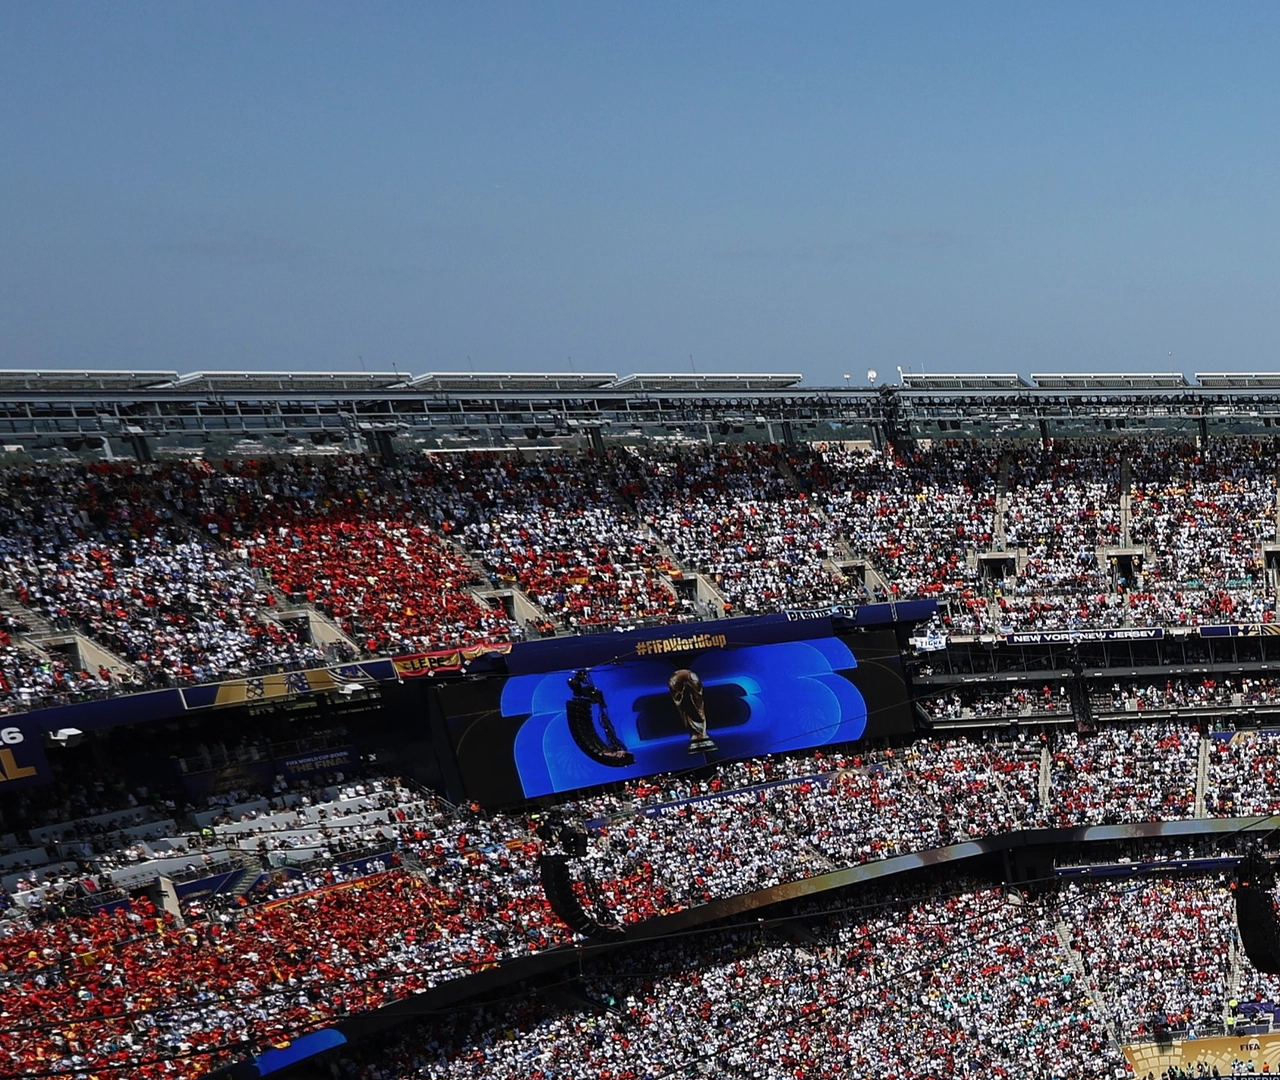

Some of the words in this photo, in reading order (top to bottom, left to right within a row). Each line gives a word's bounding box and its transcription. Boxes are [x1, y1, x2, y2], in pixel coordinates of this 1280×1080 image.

[1013, 633, 1041, 642] NEW
[1079, 631, 1106, 640] NEW
[1109, 630, 1157, 640] JERSEY
[636, 634, 727, 656] #FIFAWorldCup
[411, 656, 445, 671] LEPE
[0, 726, 25, 746] 6
[289, 762, 315, 774] THE
[315, 757, 353, 769] FINAL
[1240, 1043, 1260, 1052] FIFA
